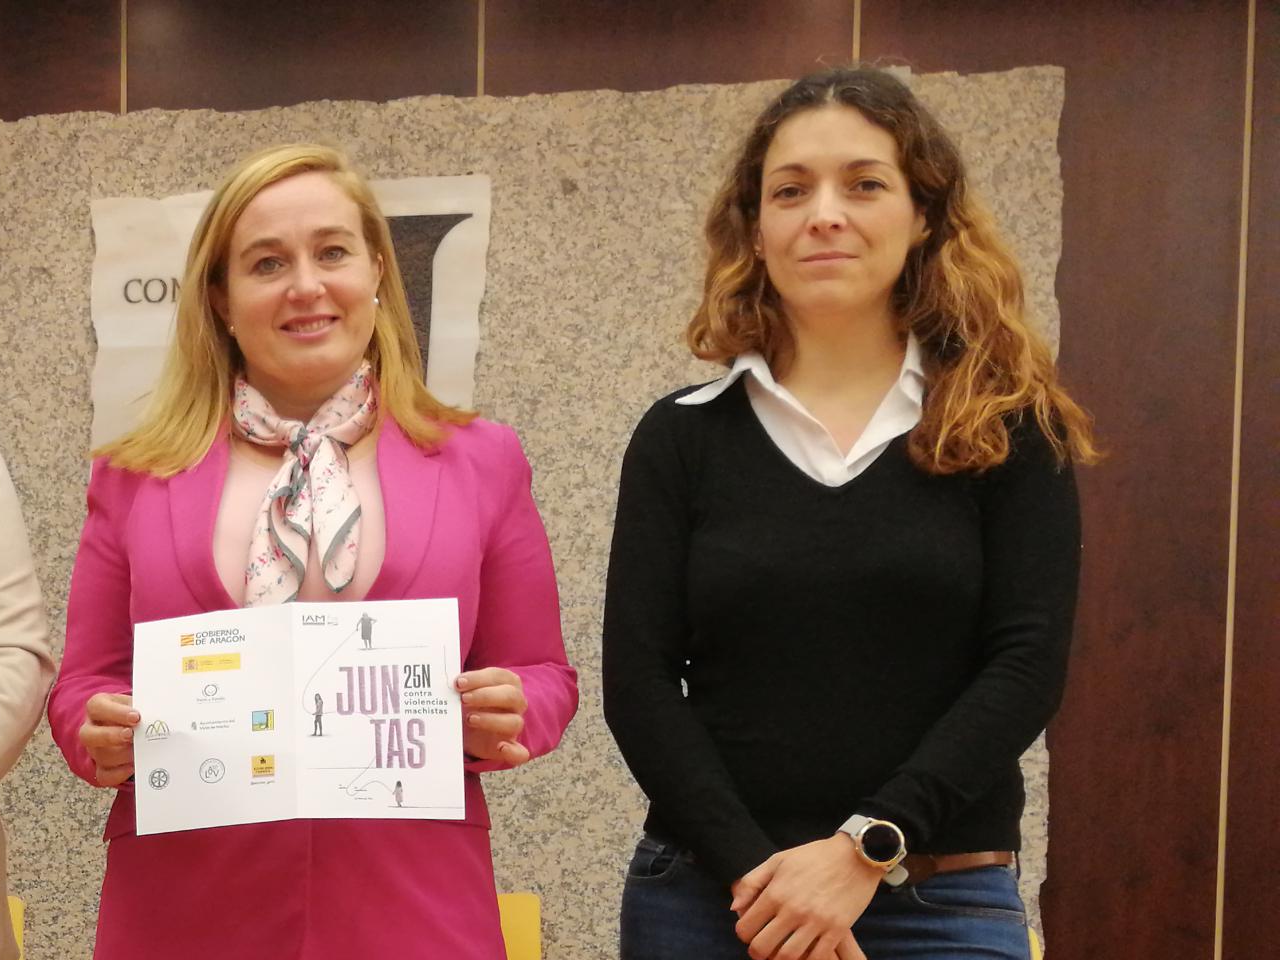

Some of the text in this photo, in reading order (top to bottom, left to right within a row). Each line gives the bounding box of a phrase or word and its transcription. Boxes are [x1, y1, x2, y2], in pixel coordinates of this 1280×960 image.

[195, 628, 239, 638] GOBIERNO
[336, 664, 400, 716] JUN
[403, 664, 431, 688] 25N
[370, 718, 426, 769] TAS
